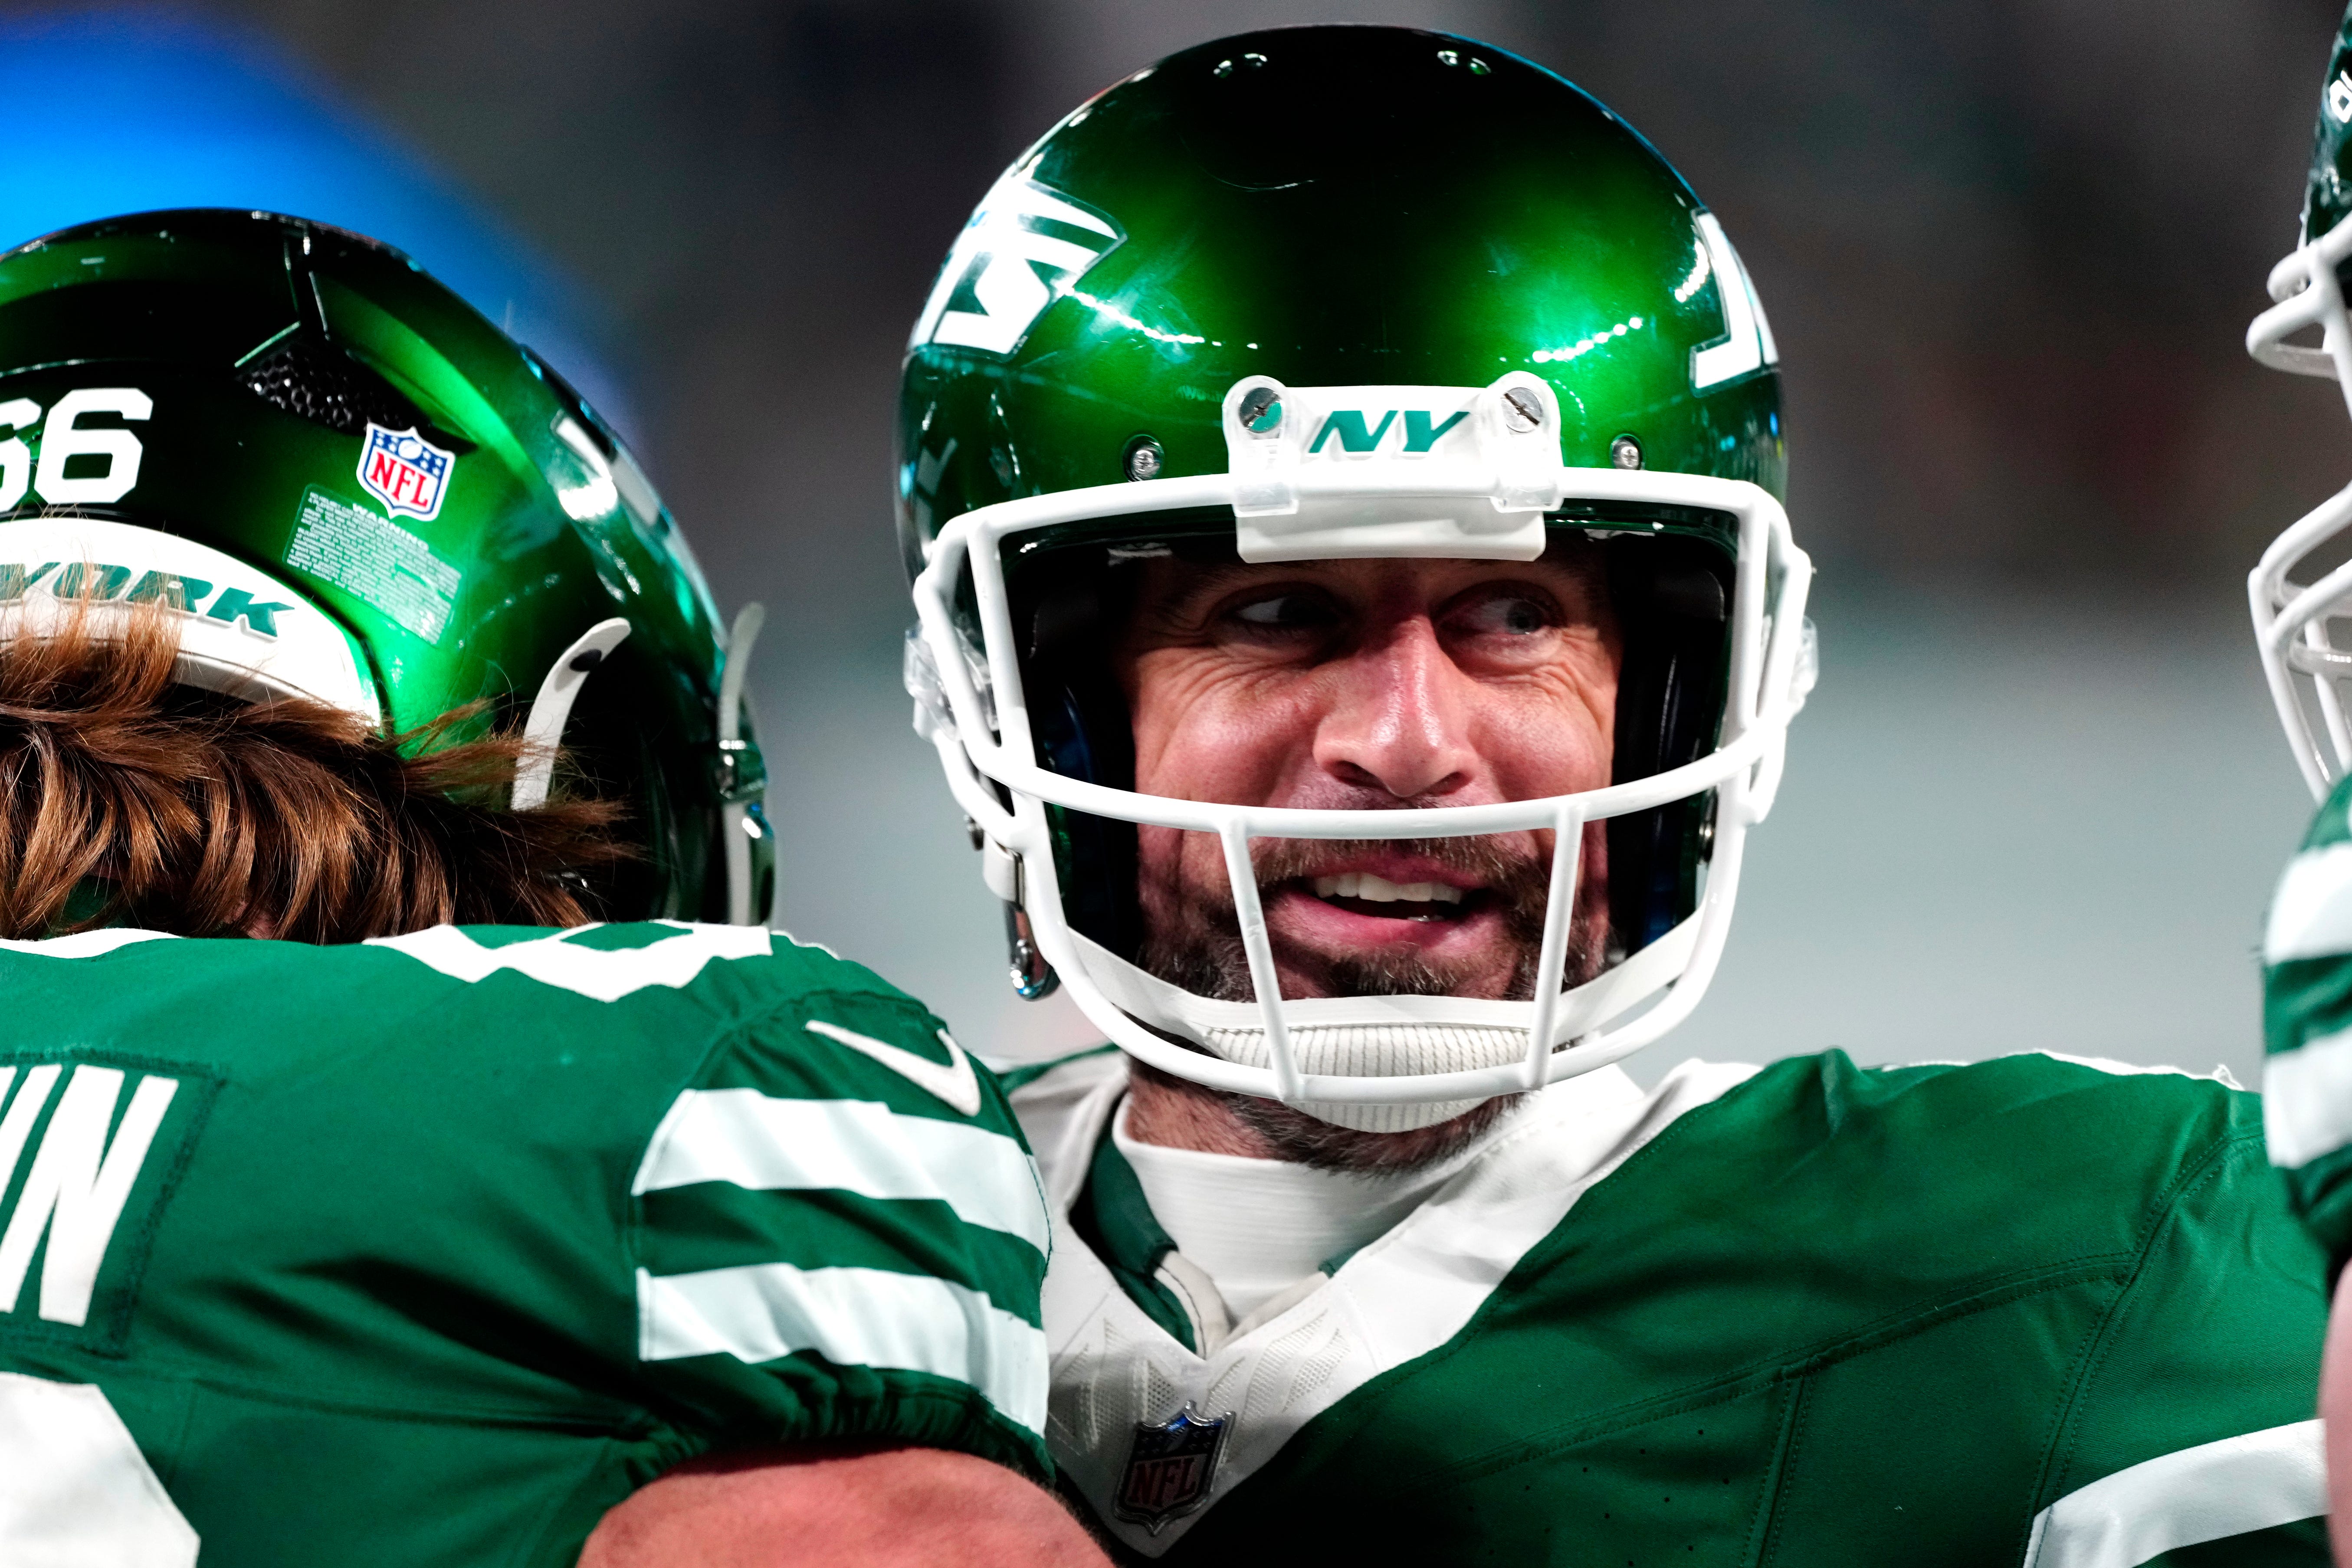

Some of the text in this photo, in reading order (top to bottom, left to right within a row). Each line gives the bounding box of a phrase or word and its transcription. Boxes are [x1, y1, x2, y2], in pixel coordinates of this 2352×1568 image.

[1309, 410, 1470, 453] NY
[370, 451, 430, 509] NFL
[352, 503, 429, 551] WARNING
[1131, 1458, 1196, 1507] NFL
